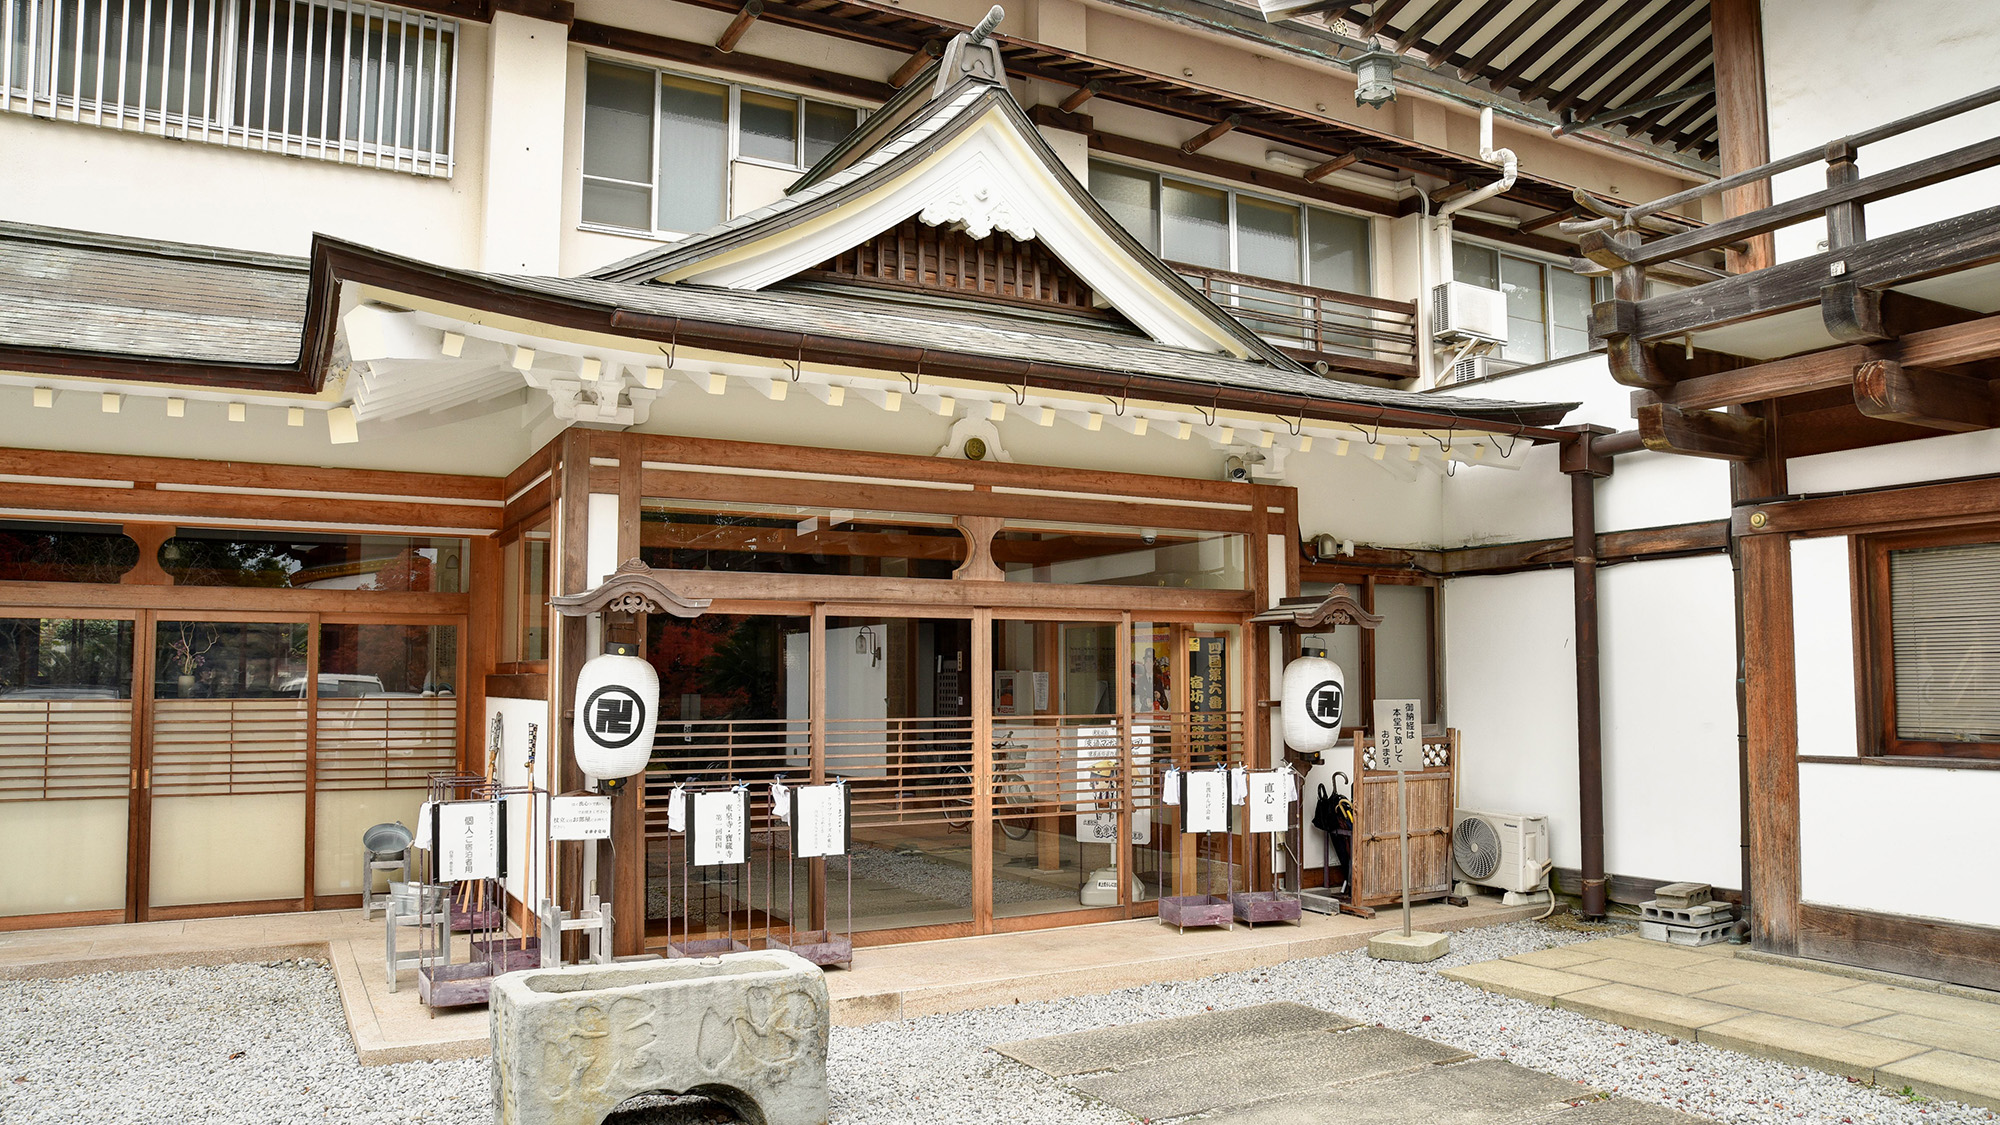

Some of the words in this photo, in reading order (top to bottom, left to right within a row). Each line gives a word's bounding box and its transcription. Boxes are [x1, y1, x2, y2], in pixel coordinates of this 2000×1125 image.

[1392, 708, 1403, 763] 本堂で致して
[1405, 703, 1415, 740] 御納経は
[1381, 730, 1391, 768] おります。
[1264, 782, 1275, 805] 直心
[1265, 813, 1274, 822] 様
